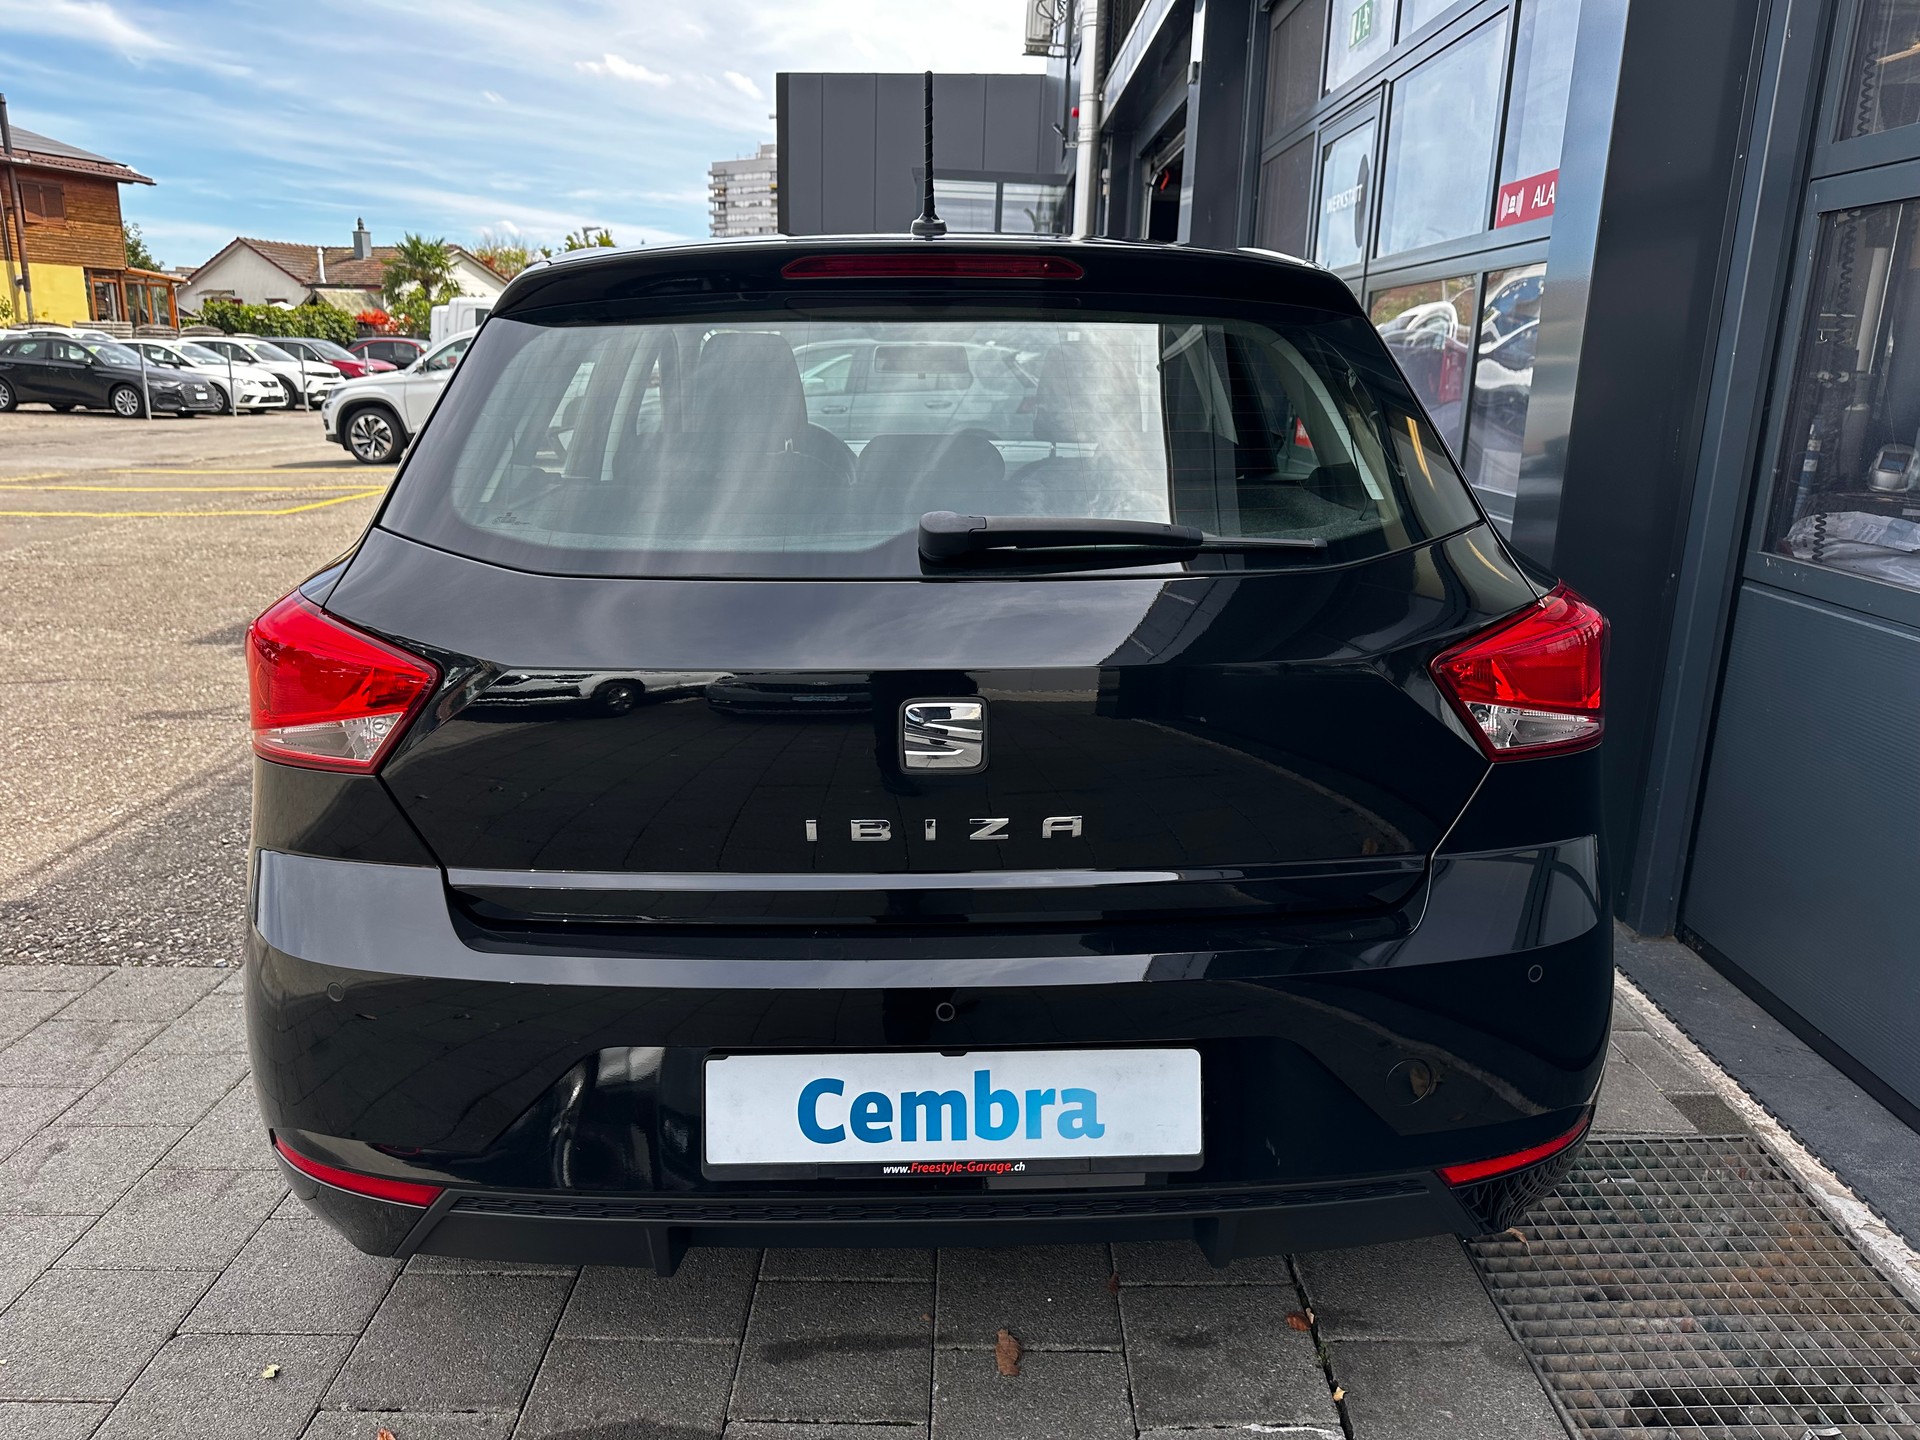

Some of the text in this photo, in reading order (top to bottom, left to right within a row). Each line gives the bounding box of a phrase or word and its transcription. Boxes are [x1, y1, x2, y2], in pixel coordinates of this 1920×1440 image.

[805, 816, 1082, 841] IBIZA
[797, 1069, 1105, 1144] Cembra
[883, 1161, 1026, 1175] www.Freestyle-Garage.ch
